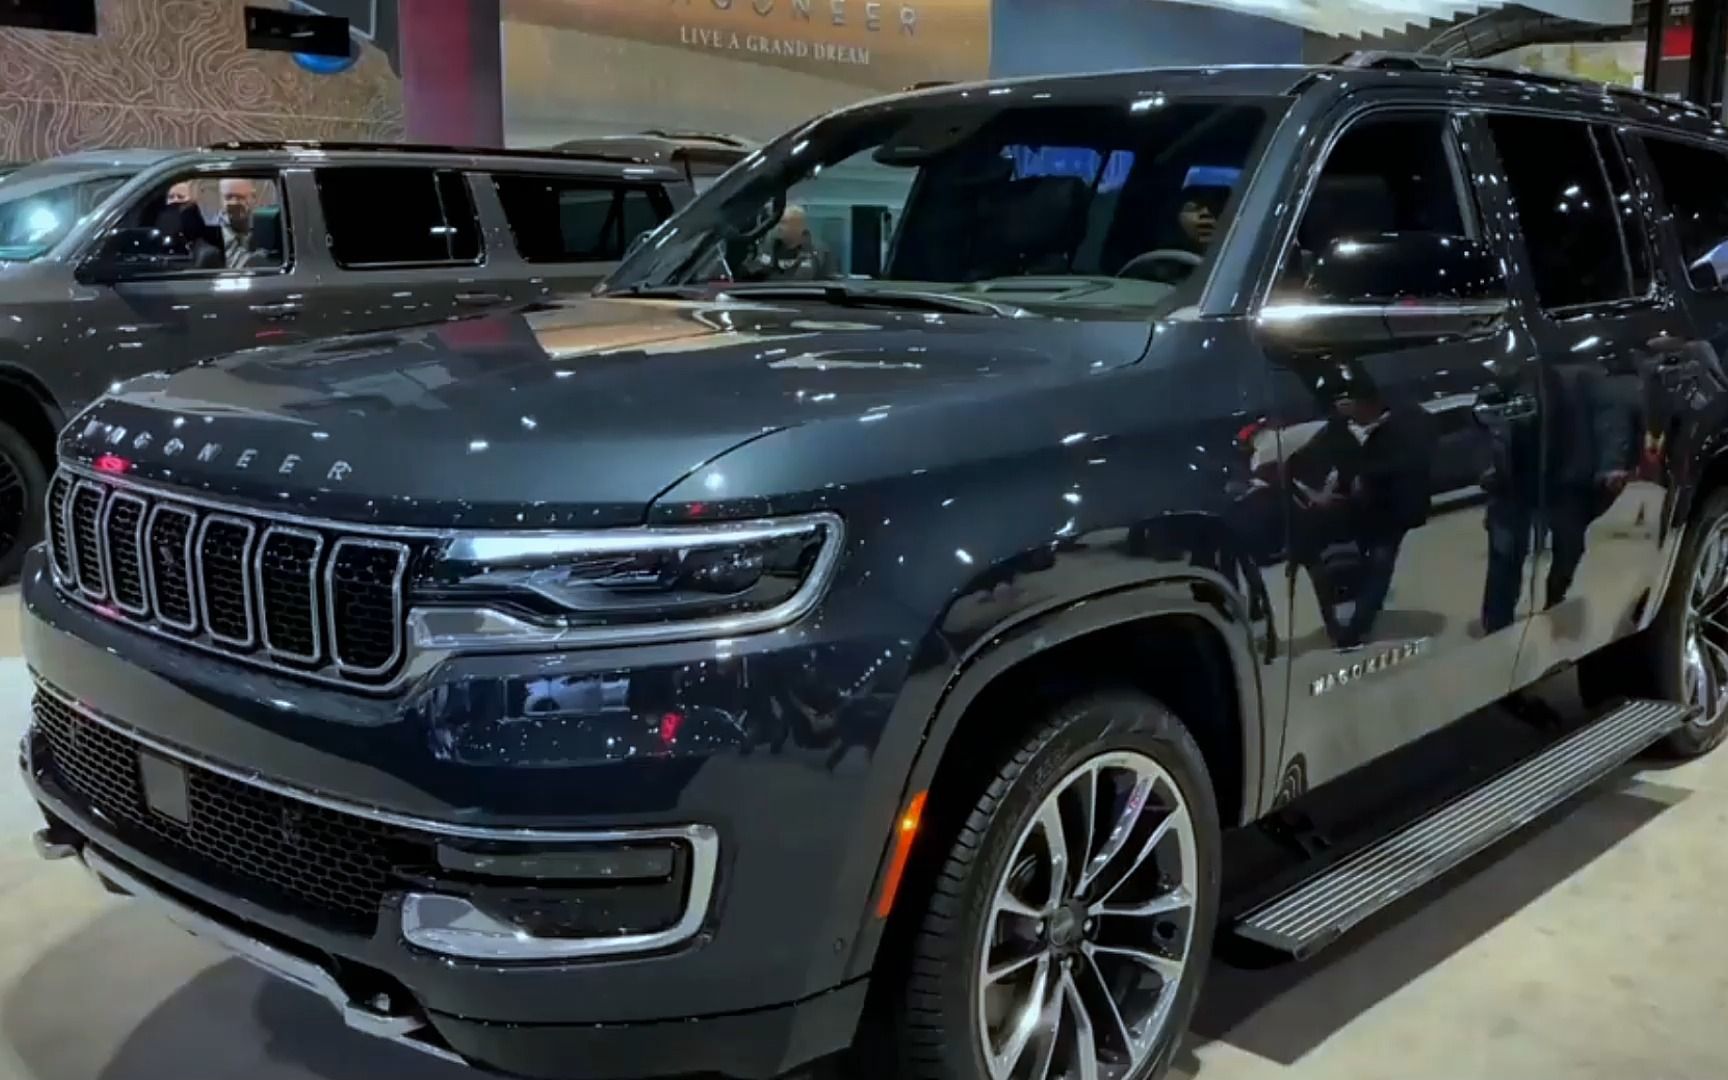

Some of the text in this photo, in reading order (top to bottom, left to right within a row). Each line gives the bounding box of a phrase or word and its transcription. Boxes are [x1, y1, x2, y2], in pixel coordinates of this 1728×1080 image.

[668, 0, 914, 36] ONEER
[680, 24, 870, 65] LIVE A GRAND DREAM
